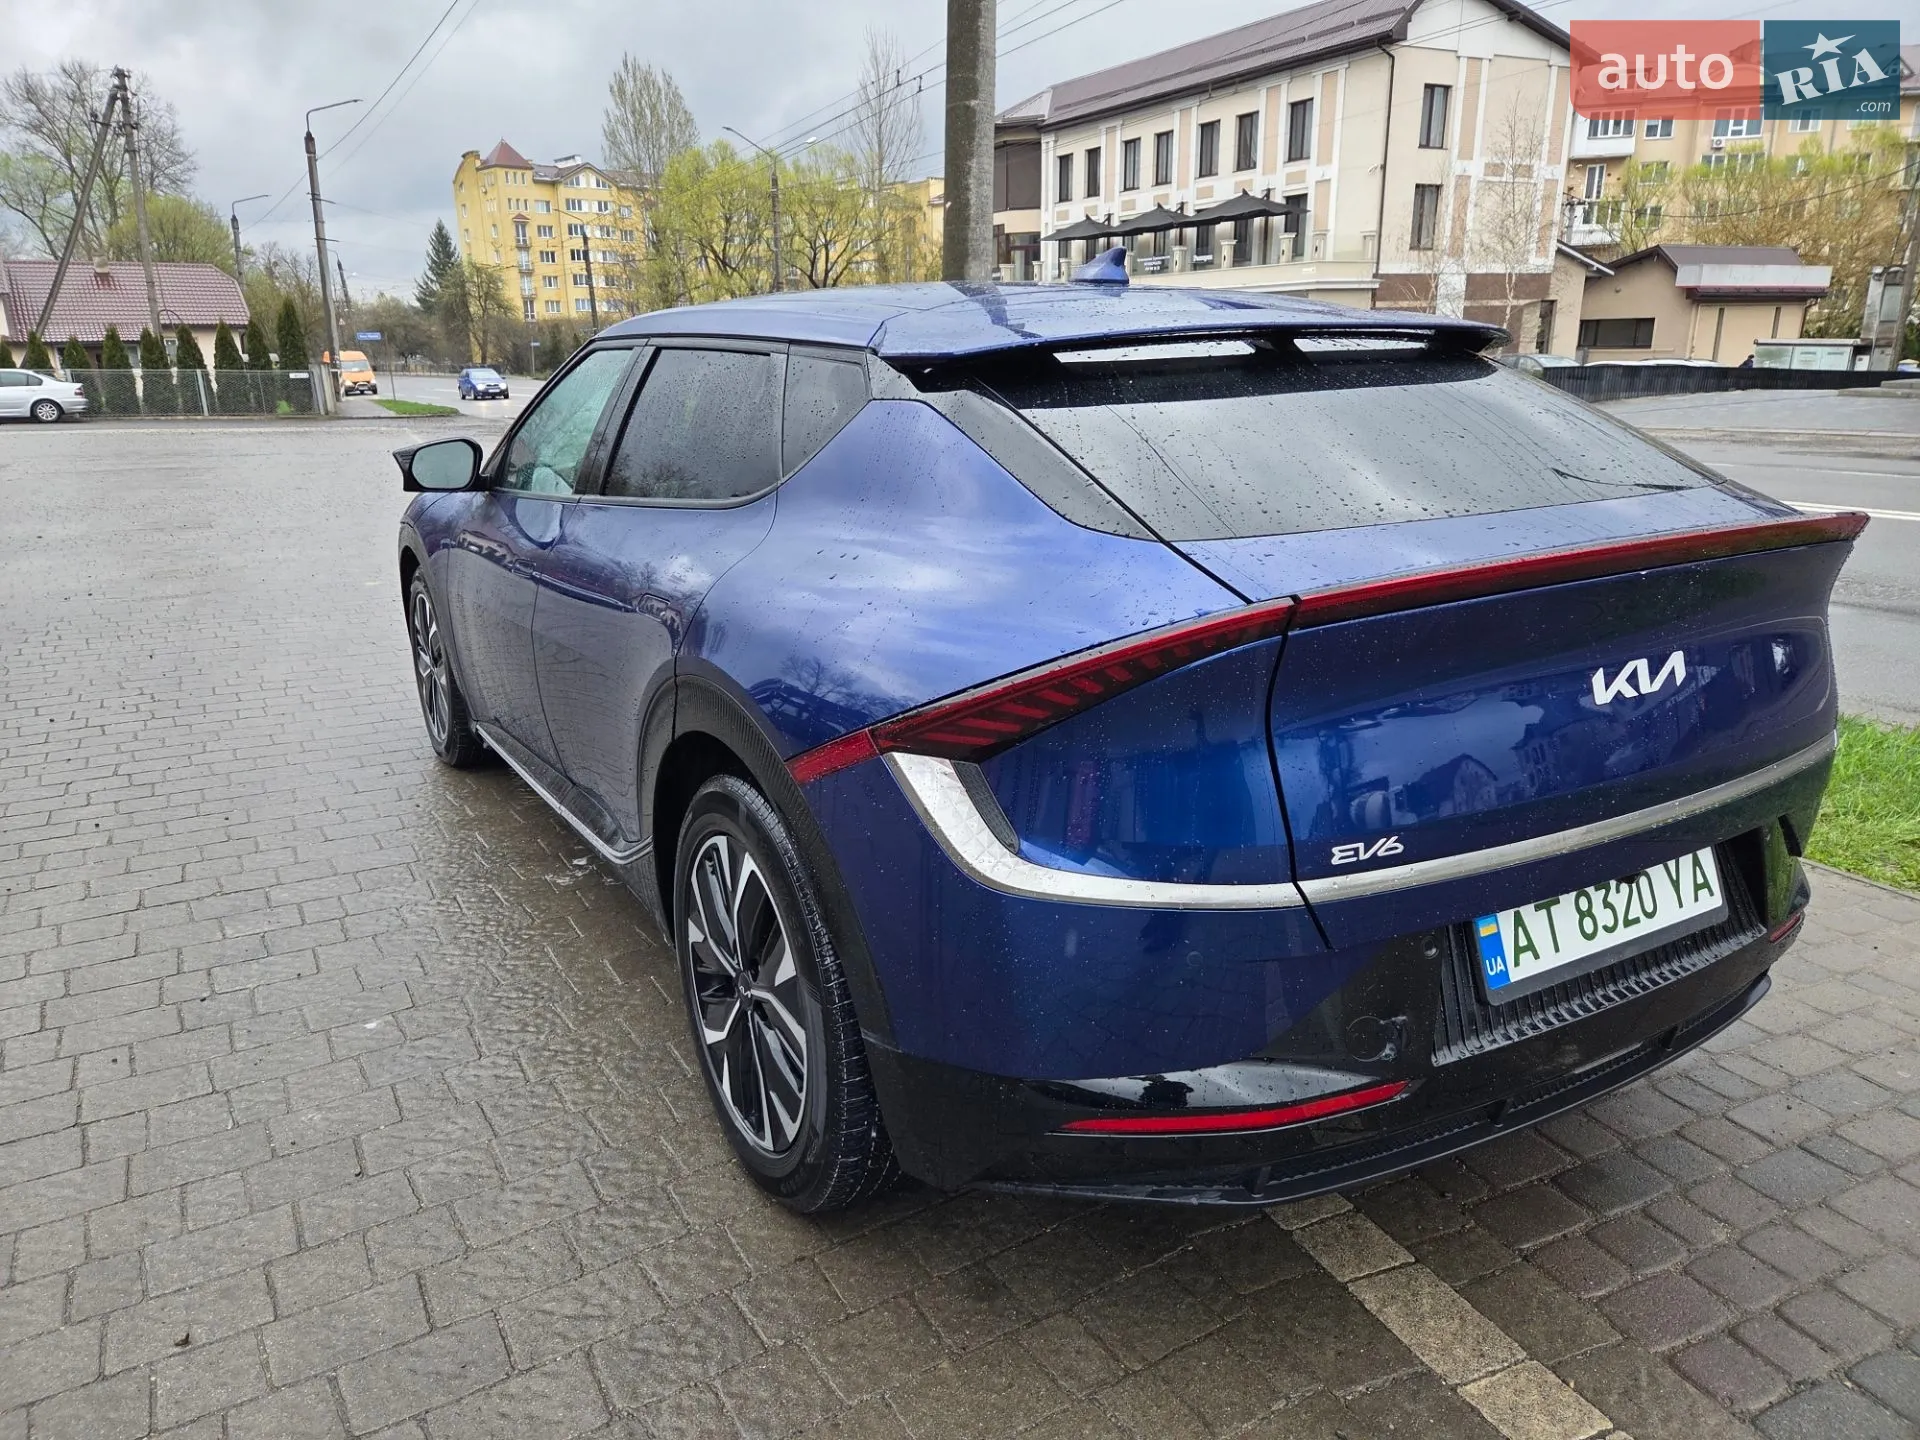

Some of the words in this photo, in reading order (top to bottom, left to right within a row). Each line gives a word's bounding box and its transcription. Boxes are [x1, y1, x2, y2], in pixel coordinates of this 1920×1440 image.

[1592, 650, 1686, 705] KIA
[1331, 835, 1404, 865] EV6
[1513, 898, 1560, 968] AT
[1574, 870, 1658, 942] 8320
[1662, 851, 1715, 909] YA
[1486, 957, 1505, 976] UA
